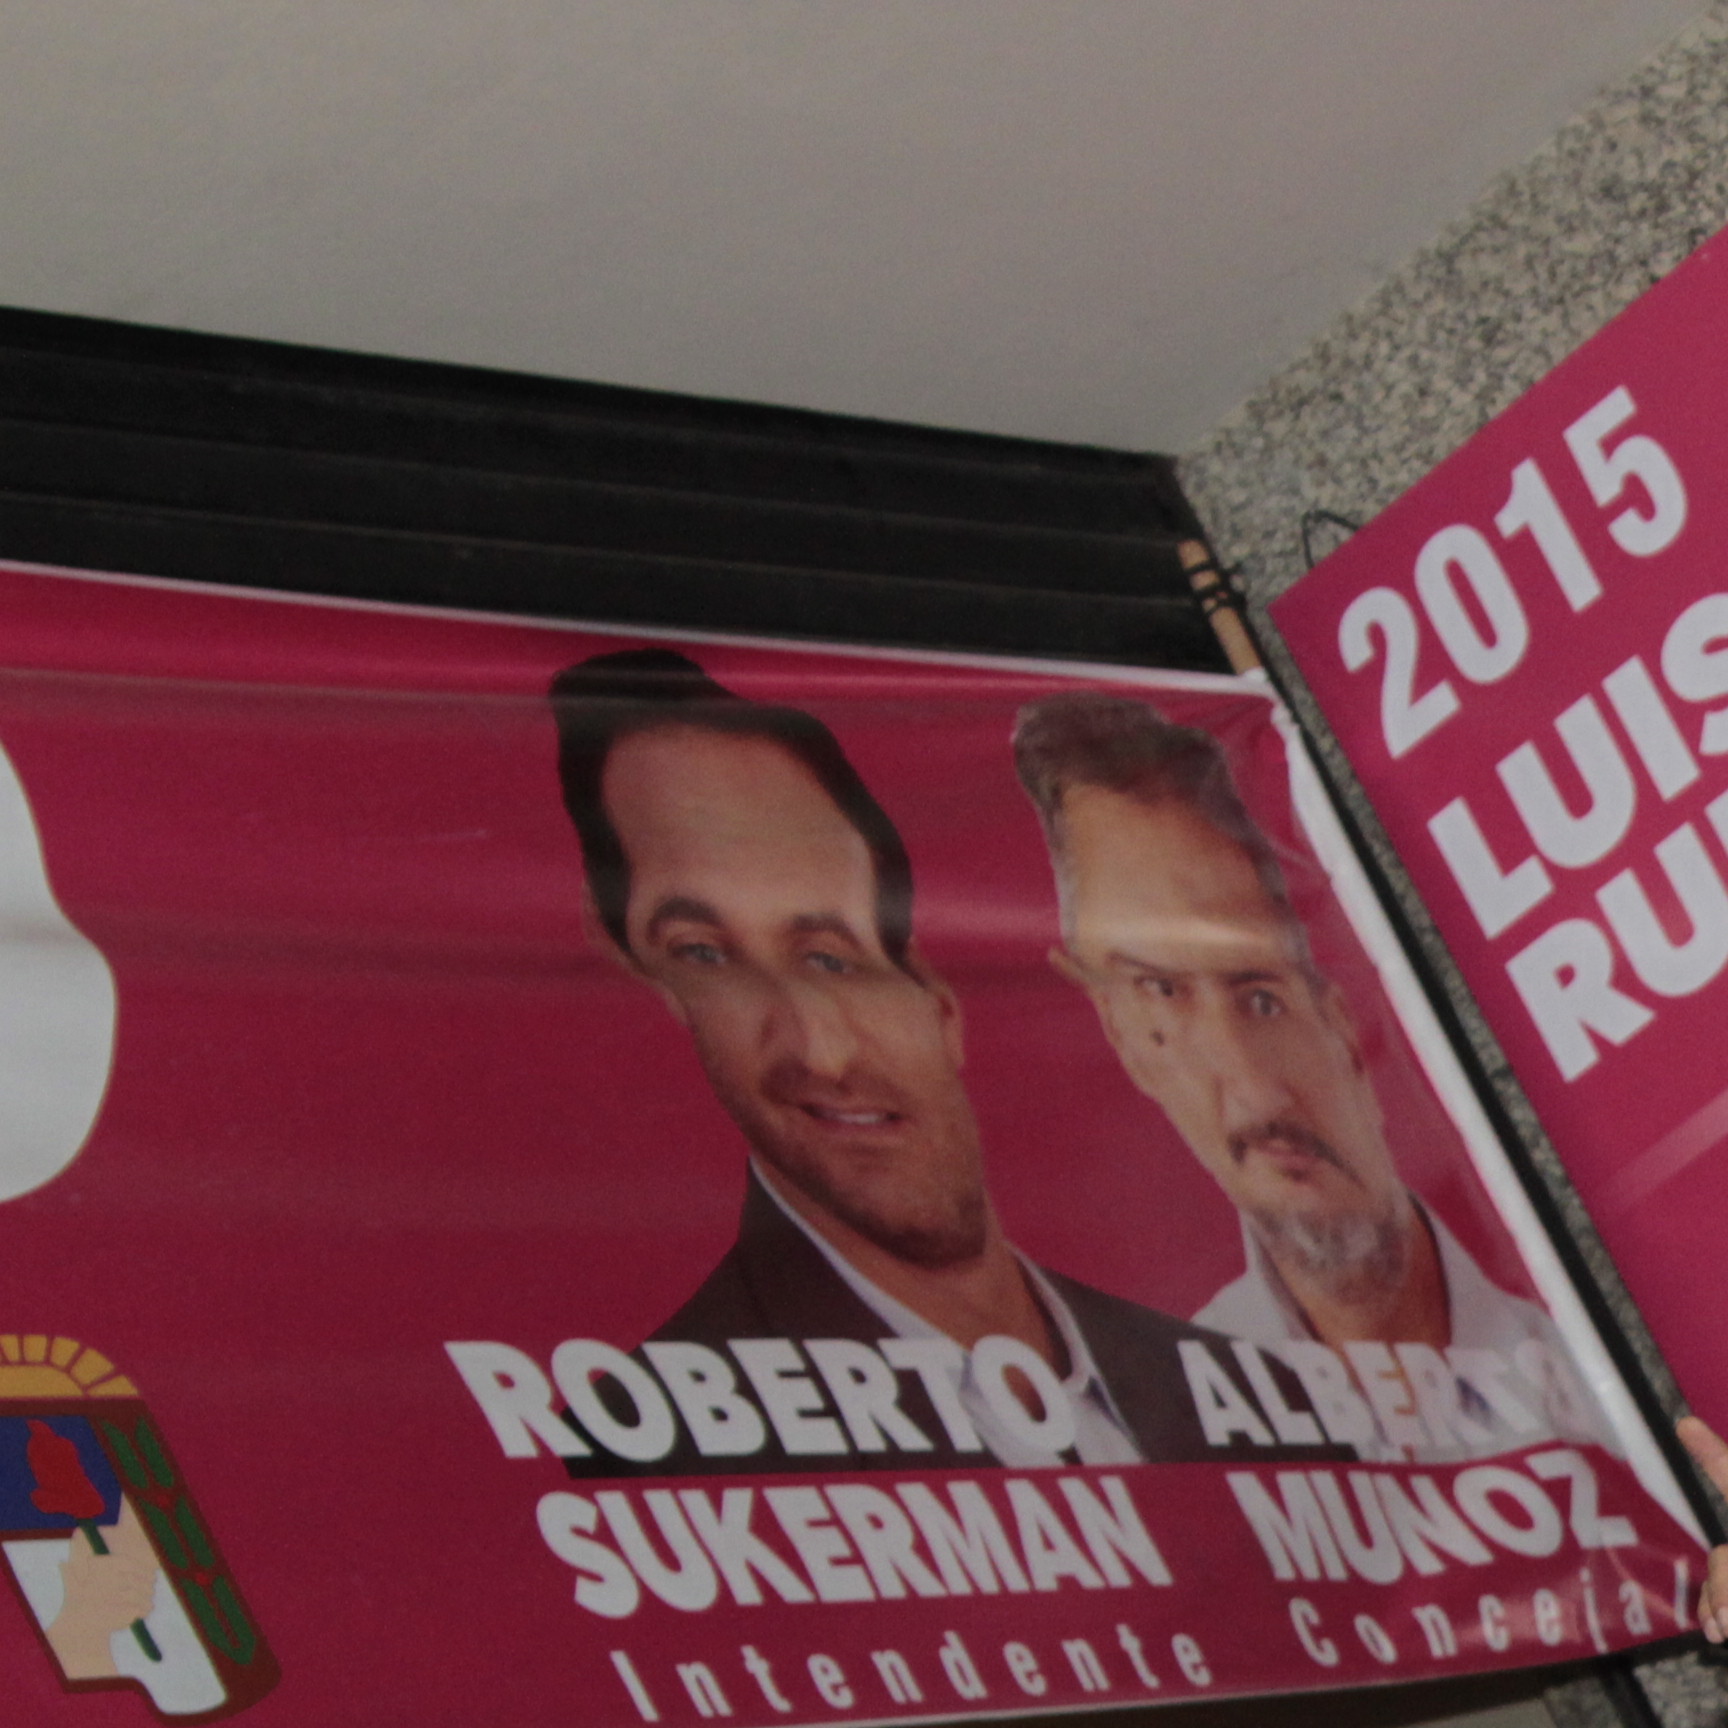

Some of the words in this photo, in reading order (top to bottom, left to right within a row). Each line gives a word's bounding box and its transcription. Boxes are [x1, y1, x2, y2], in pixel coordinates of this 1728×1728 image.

[1337, 385, 1689, 760] 2015
[443, 1335, 1079, 1462] ROBERTO
[536, 1475, 1174, 1619] SUKERMAN
[610, 1623, 1212, 1723] Intendente
[1288, 1557, 1692, 1668] Concejal
